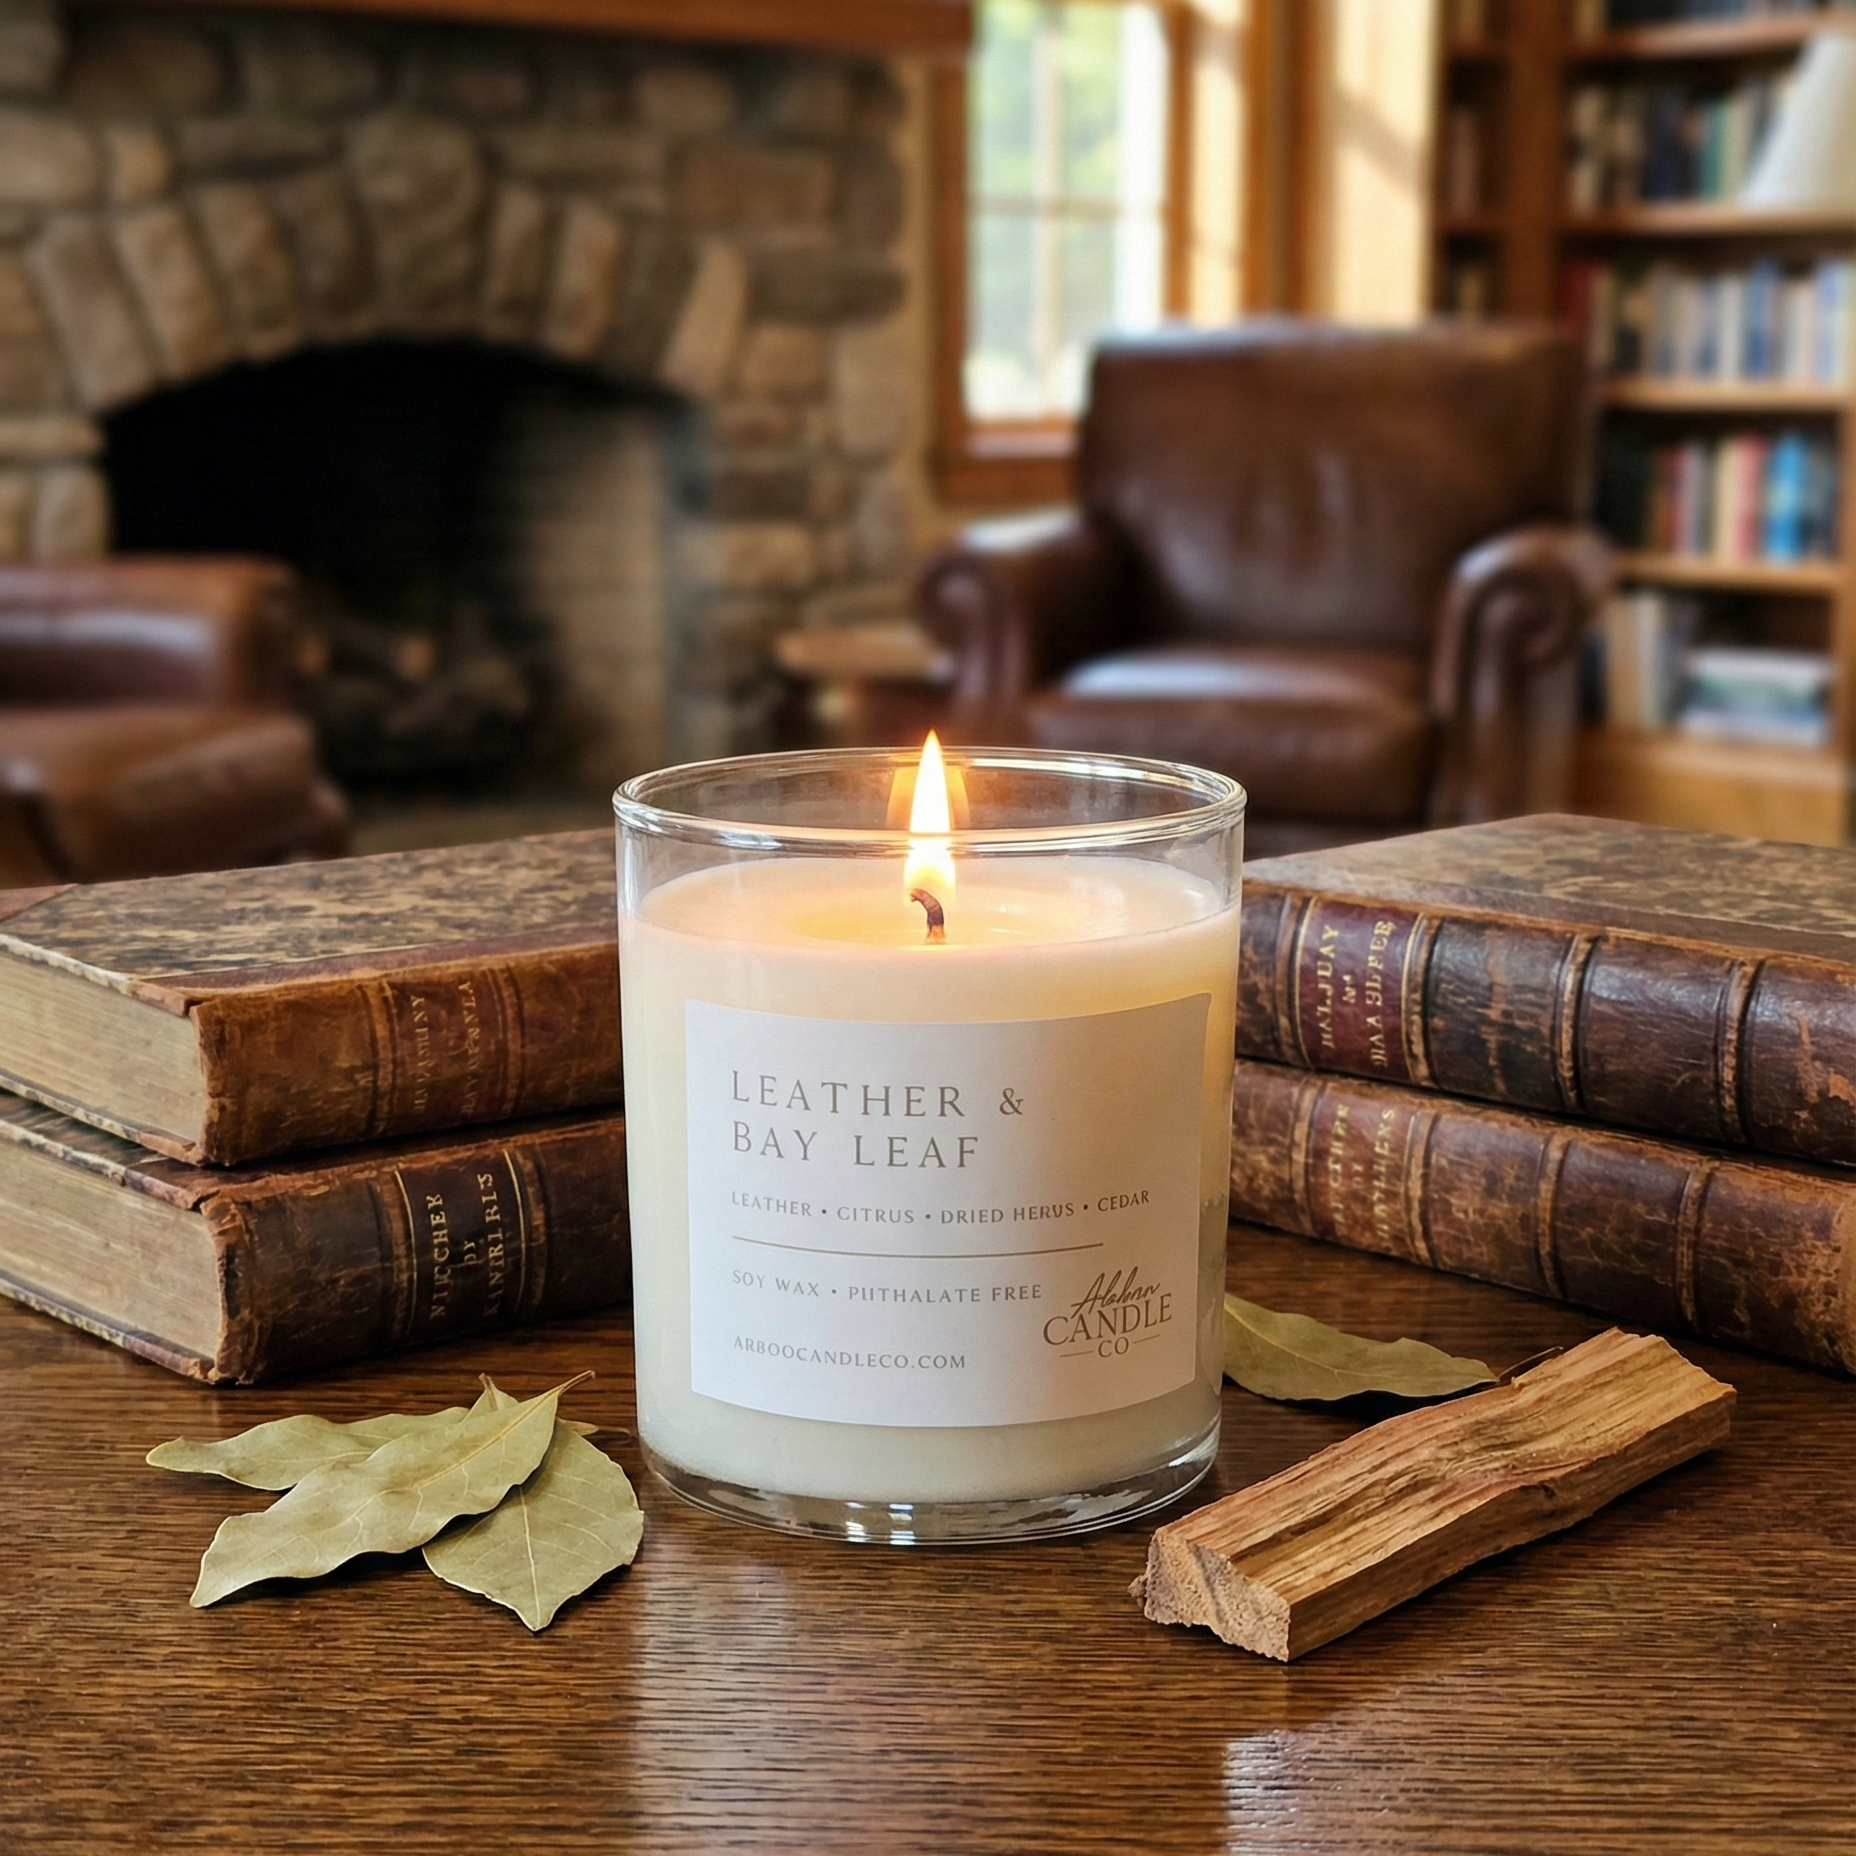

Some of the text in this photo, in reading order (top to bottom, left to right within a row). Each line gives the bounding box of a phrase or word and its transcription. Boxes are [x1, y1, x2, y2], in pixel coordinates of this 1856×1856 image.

[732, 1070, 1024, 1117] LEATHER &
[732, 1121, 979, 1168] BAY LEAF
[732, 1191, 812, 1217] LEATHER
[837, 1206, 915, 1224] CITRUS
[940, 1208, 1004, 1224] DRIED
[1097, 1190, 1150, 1212] CEDAR
[732, 1269, 766, 1289] SOY
[775, 1277, 819, 1297] WAX
[992, 1284, 1042, 1301] FREE
[1043, 1292, 1173, 1346] CANDLE
[1097, 1336, 1130, 1358] CO
